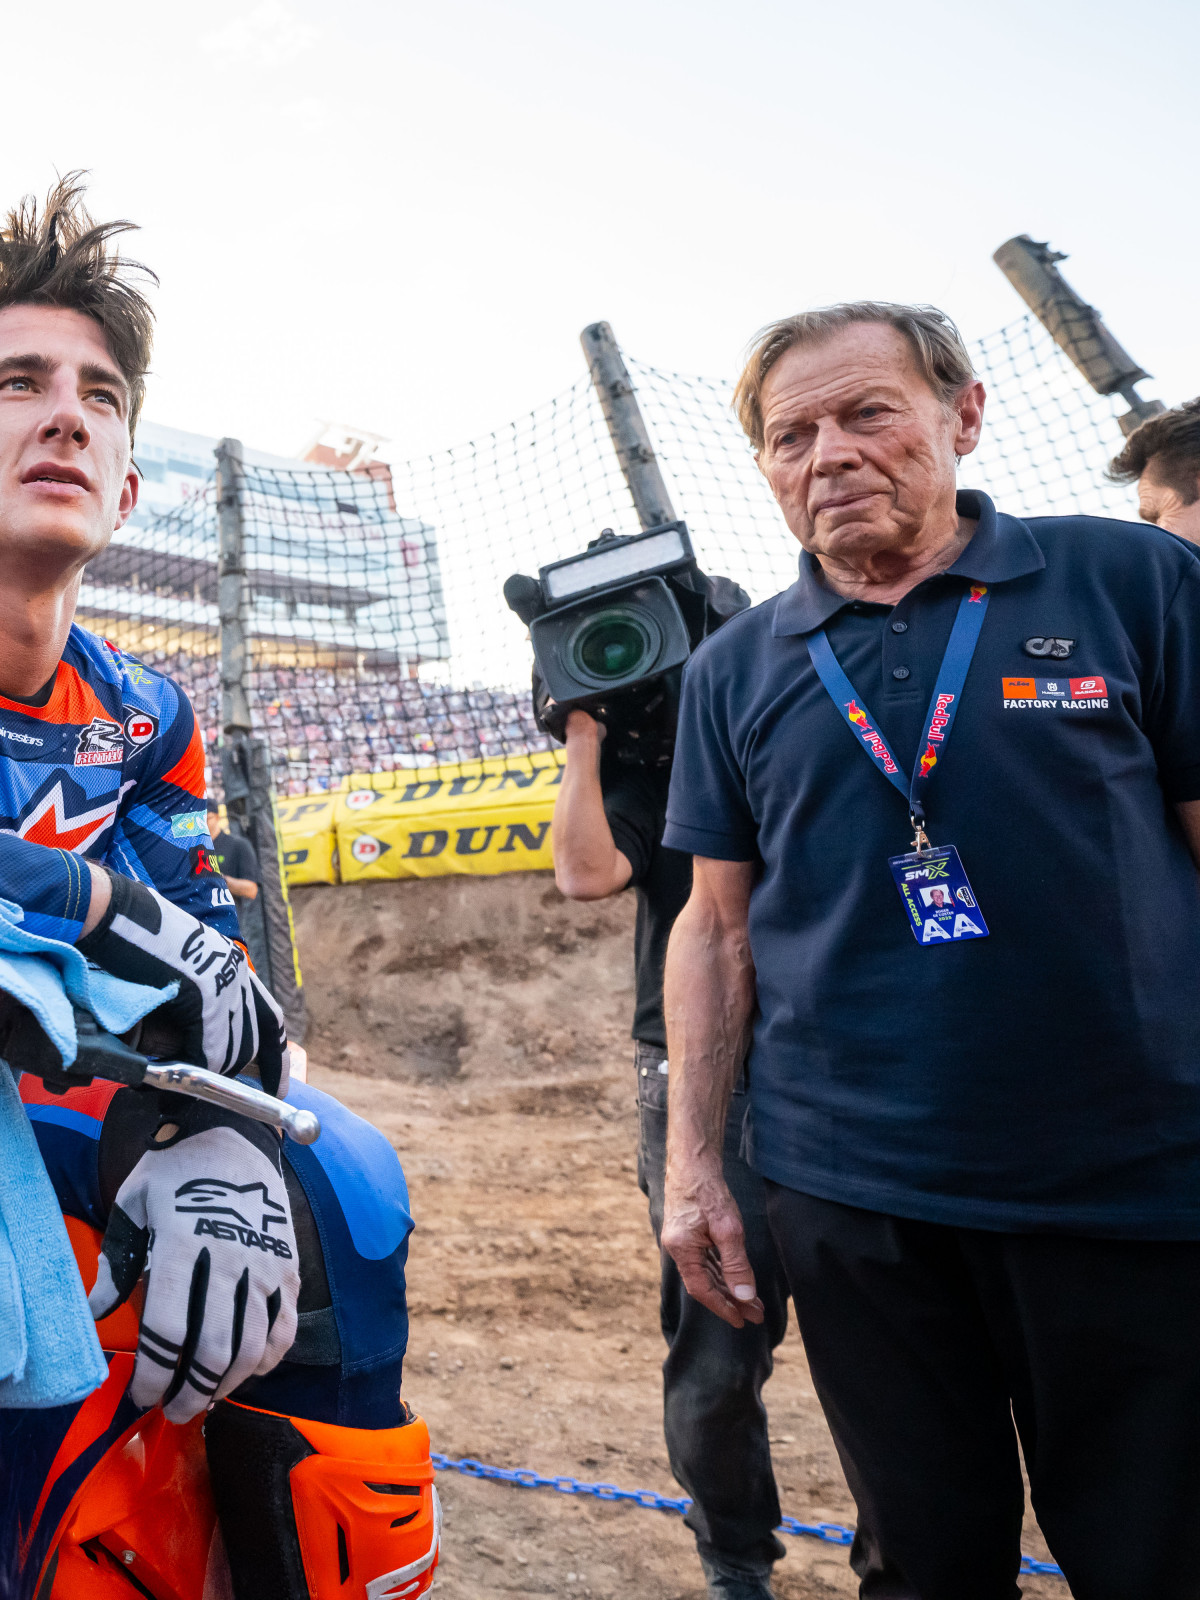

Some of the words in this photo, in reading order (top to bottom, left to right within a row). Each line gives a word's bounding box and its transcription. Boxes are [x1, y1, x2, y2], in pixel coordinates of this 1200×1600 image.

[933, 693, 955, 718] Red
[1003, 699, 1058, 710] FACTORY
[1061, 698, 1110, 710] RACING
[131, 721, 153, 738] D
[928, 717, 949, 741] Bull
[862, 731, 887, 754] Bull
[75, 749, 124, 766] RENTH
[875, 751, 899, 774] Red
[394, 764, 567, 804] DUN
[401, 821, 553, 859] DUN
[905, 862, 950, 881] SMX
[901, 882, 909, 898] ALL
[906, 897, 923, 927] ACCESS
[193, 1217, 293, 1260] ASTARS
